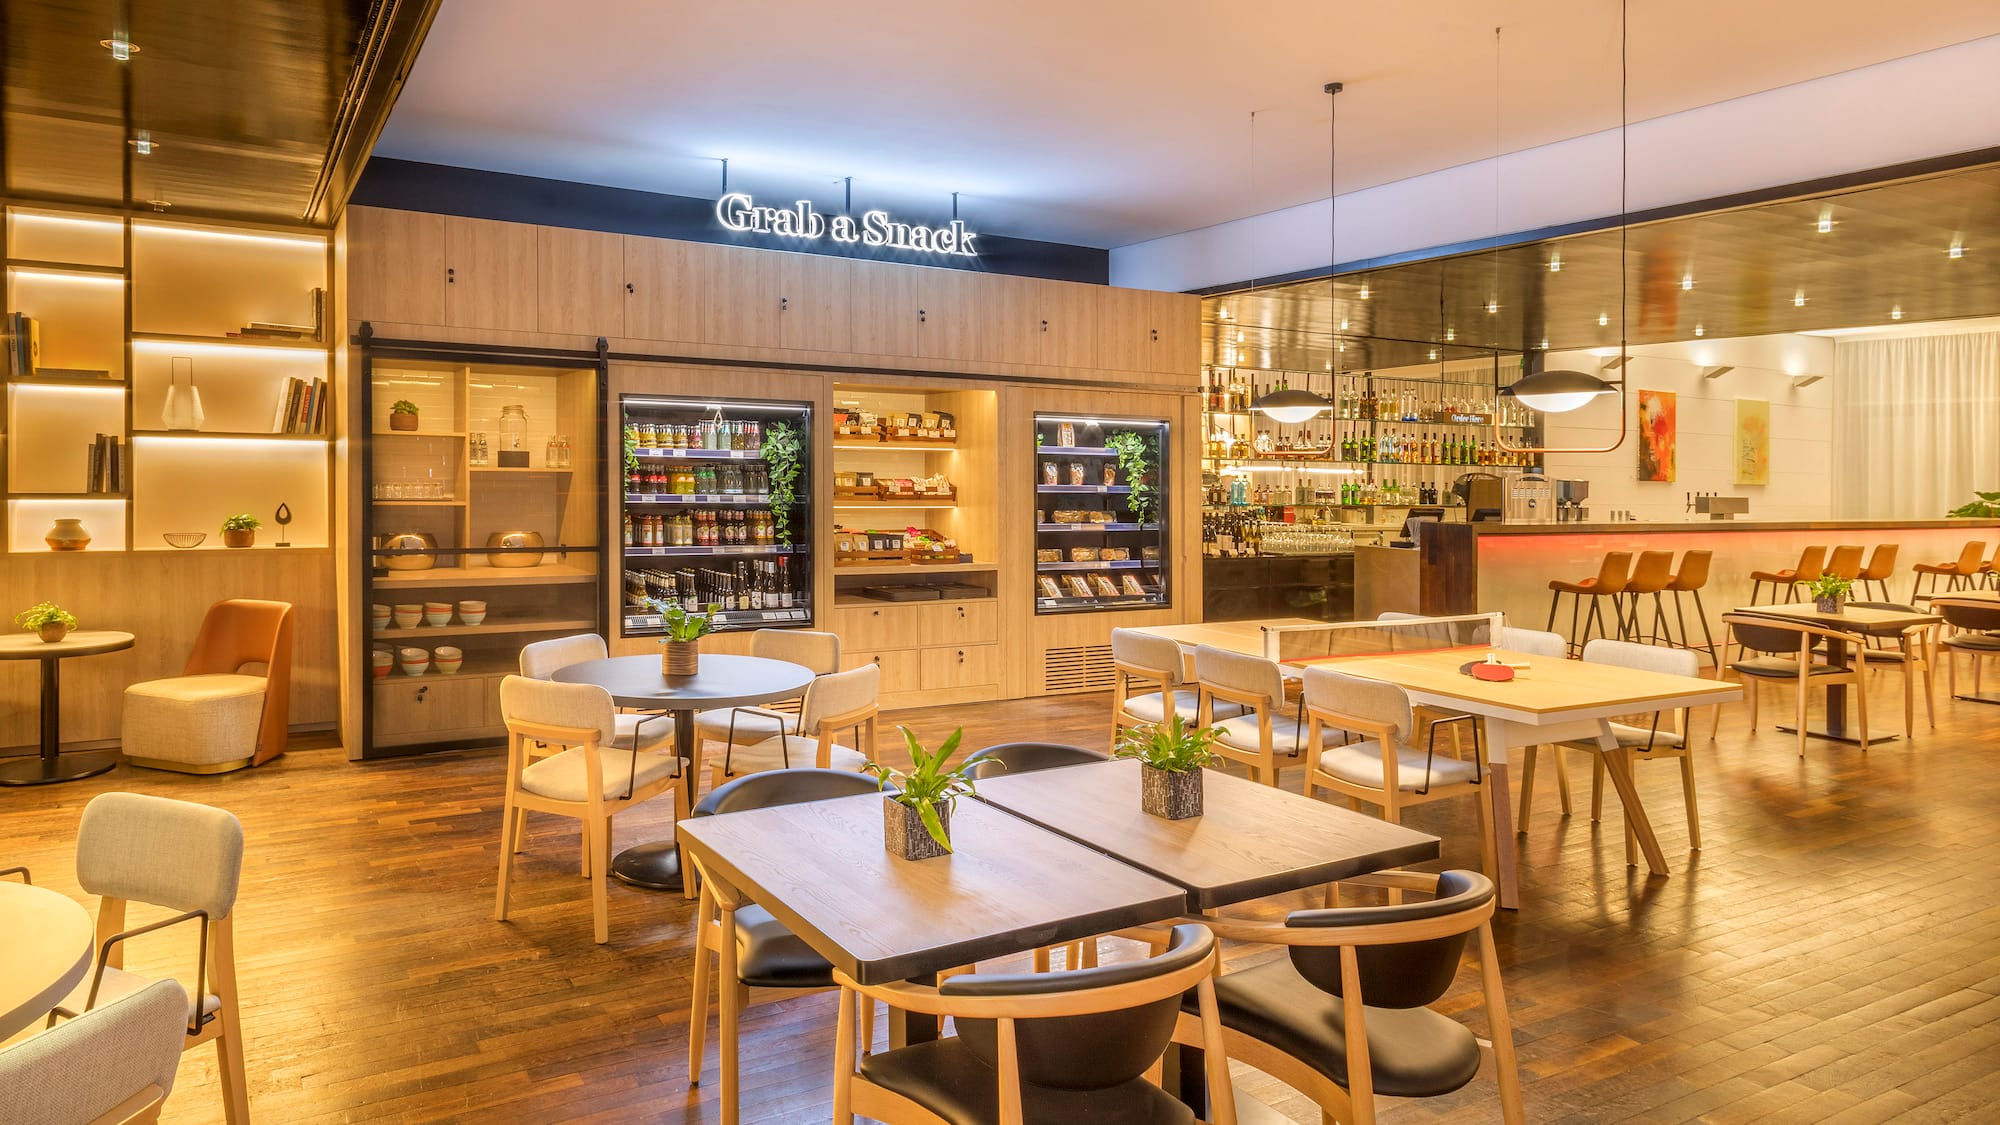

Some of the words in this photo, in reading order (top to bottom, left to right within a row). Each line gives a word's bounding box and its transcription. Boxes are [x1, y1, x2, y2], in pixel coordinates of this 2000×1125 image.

[716, 193, 825, 239] Grab
[831, 215, 860, 243] a
[863, 210, 978, 257] Snack
[1451, 414, 1469, 423] Order
[1470, 415, 1484, 423] Here
